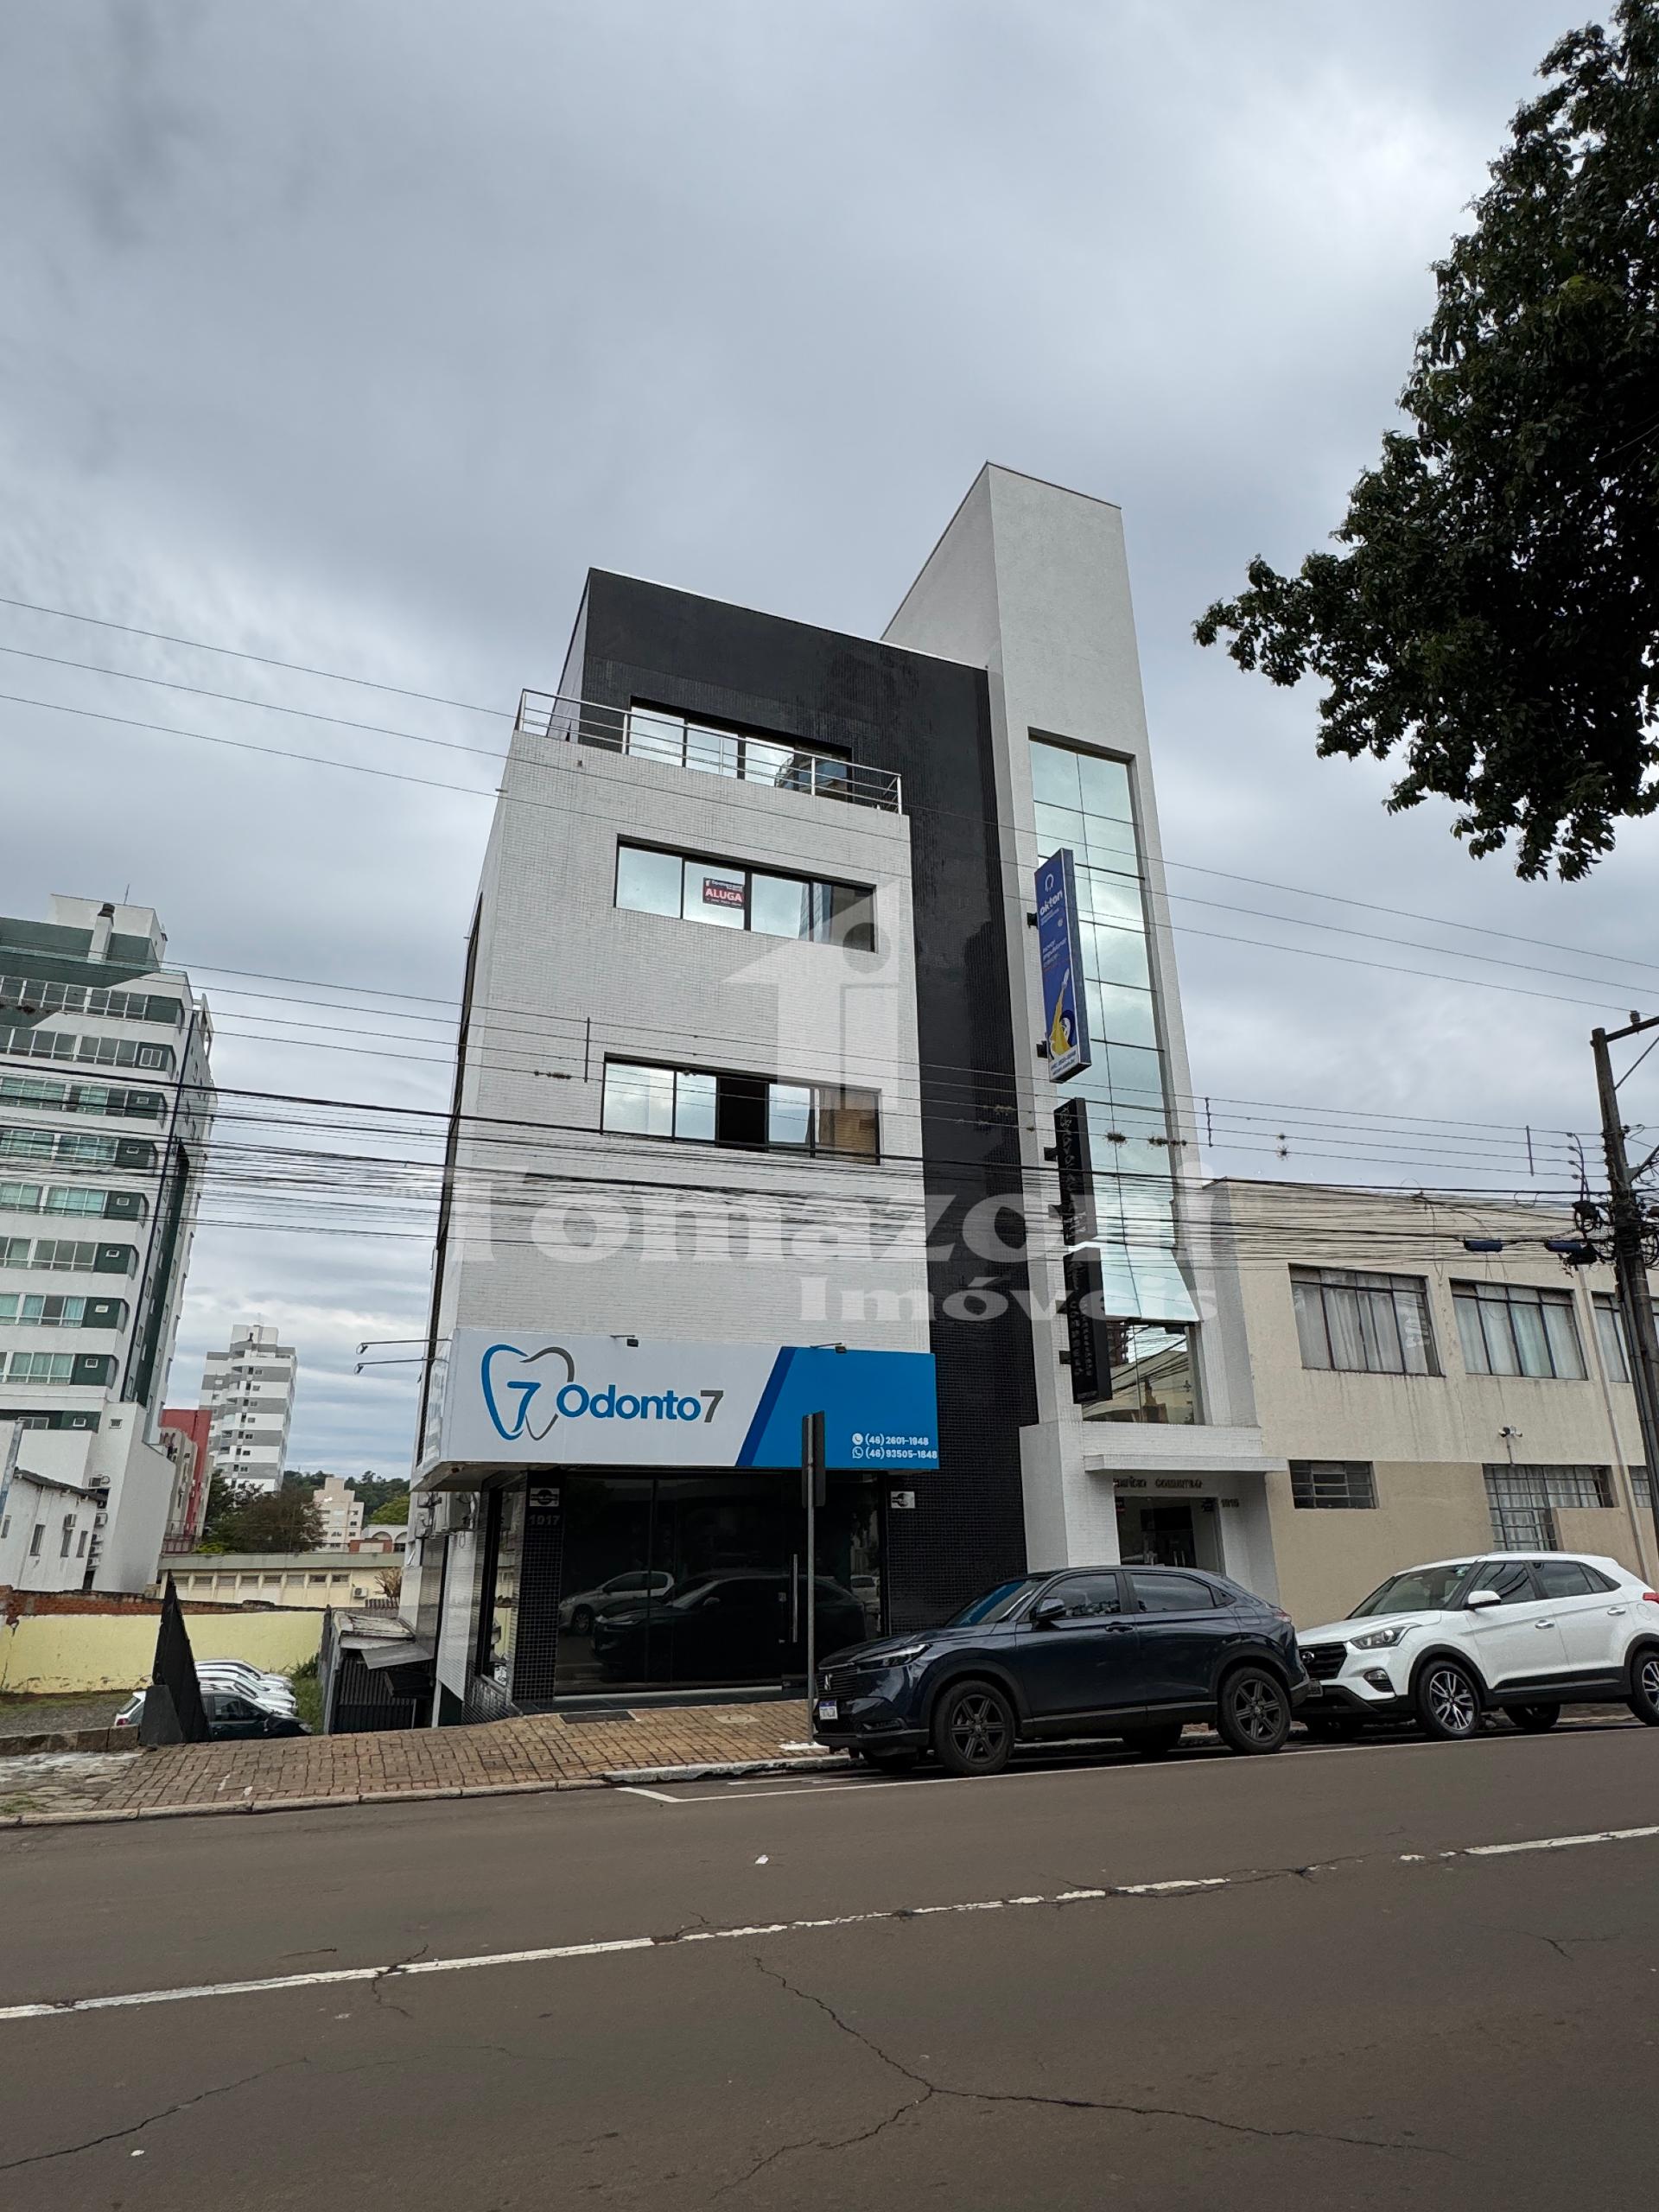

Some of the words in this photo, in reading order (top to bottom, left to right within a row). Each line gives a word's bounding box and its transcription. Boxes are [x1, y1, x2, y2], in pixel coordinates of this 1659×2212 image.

[704, 887, 743, 903] ALUGA
[556, 1383, 724, 1423] Odonto7
[865, 1446, 885, 1459] (46)
